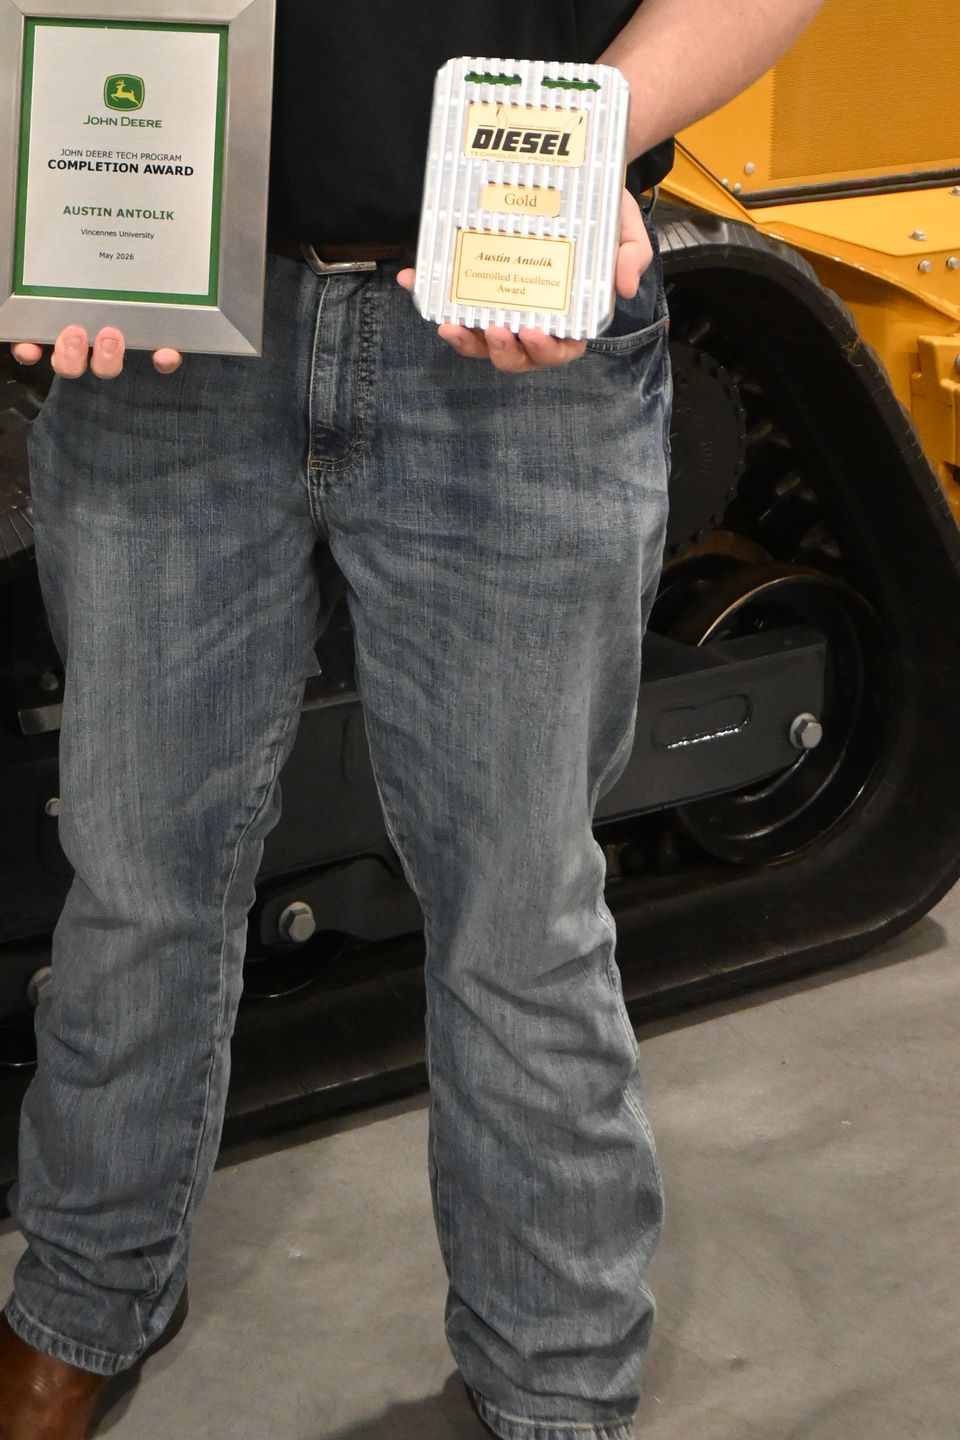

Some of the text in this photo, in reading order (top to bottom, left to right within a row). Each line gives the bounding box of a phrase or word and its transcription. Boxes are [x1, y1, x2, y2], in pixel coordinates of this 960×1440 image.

[83, 115, 162, 128] JOHN DEERE
[471, 128, 571, 156] DIESEL
[60, 148, 182, 161] JOHN DEERE TECH PROGRAM
[47, 159, 194, 176] COMPLETION AWARD
[504, 193, 538, 207] Gold
[63, 205, 174, 220] AUSTIN ANTOLIK
[80, 228, 154, 240] Vincennes University
[99, 252, 135, 260] May 2026
[474, 251, 553, 267] Austin Antolik
[464, 269, 560, 287] Controlled Excellence
[497, 284, 526, 295] Award
